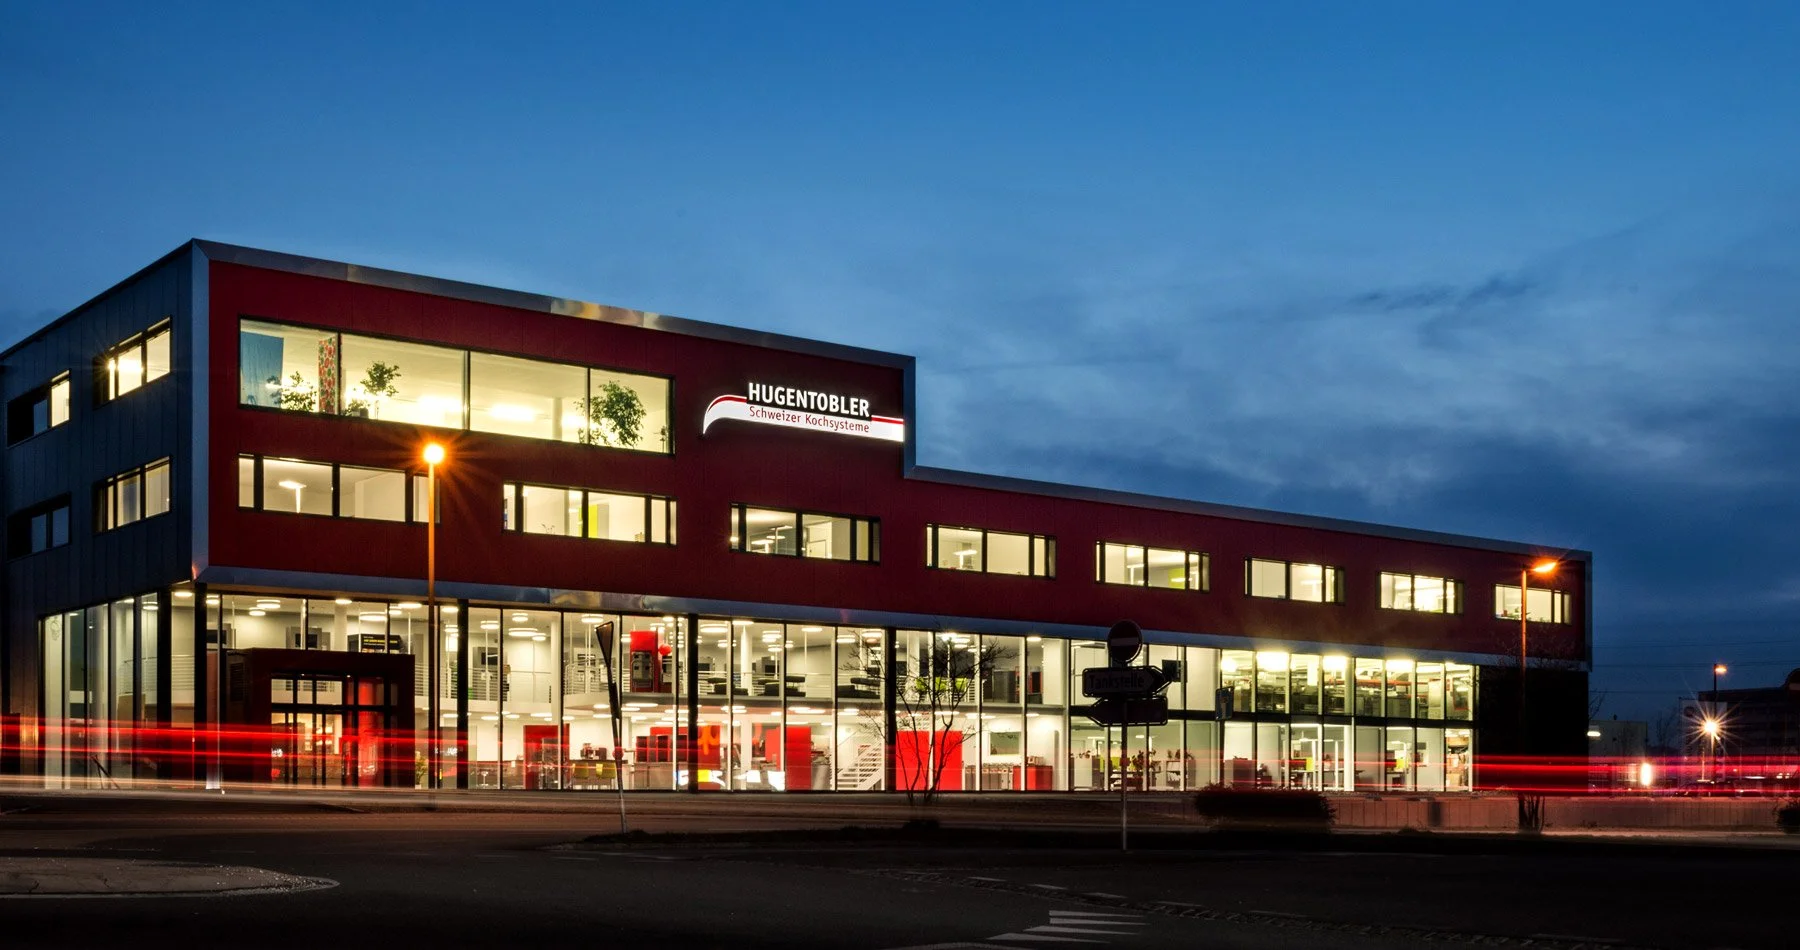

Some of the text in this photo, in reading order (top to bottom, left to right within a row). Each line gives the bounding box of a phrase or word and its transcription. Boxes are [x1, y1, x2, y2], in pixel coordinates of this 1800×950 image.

[748, 382, 870, 418] HUGENTOBLER
[749, 406, 870, 433] Schweizer Kochsysteme
[1089, 672, 1145, 690] Tankstelle
